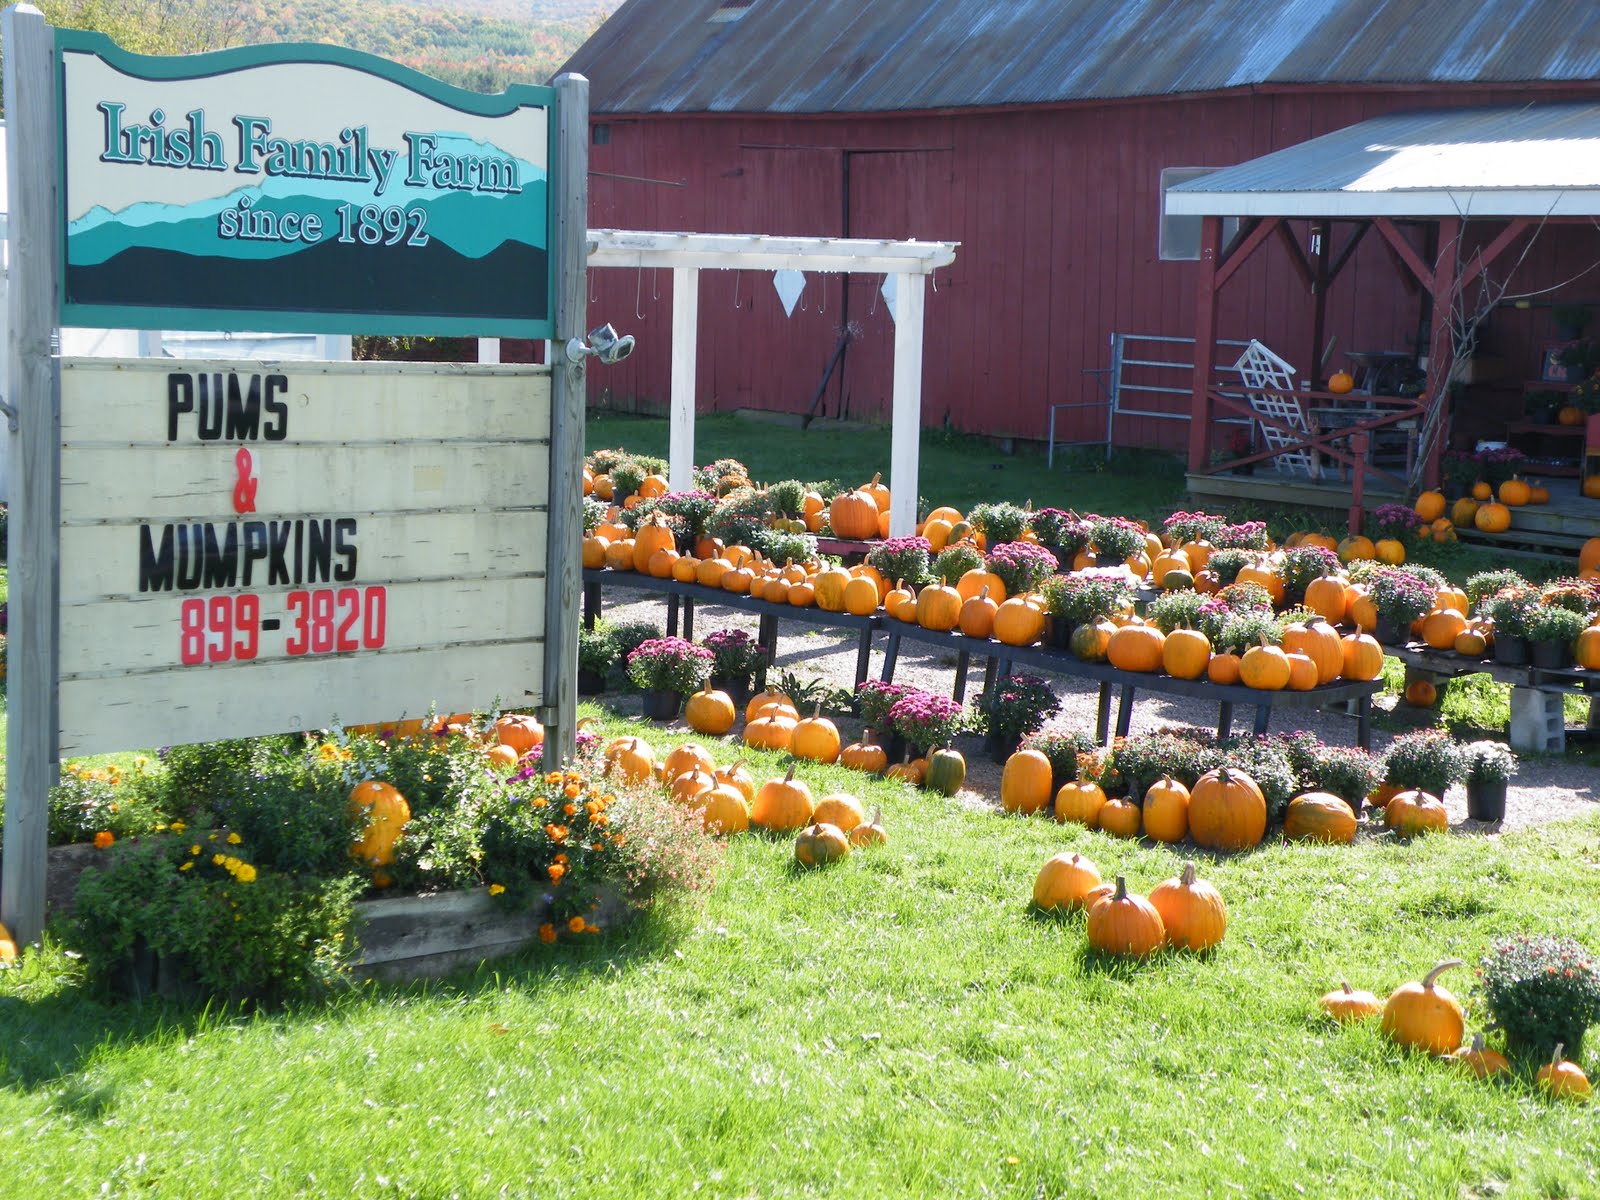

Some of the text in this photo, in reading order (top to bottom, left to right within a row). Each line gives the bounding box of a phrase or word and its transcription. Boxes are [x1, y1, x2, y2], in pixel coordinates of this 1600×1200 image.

[98, 101, 522, 196] Irish Family Farm
[218, 196, 430, 249] since 1892
[167, 373, 289, 442] PUMS
[232, 447, 258, 514] &
[138, 518, 357, 592] MUMPKINS
[180, 586, 387, 665] 899-3820
